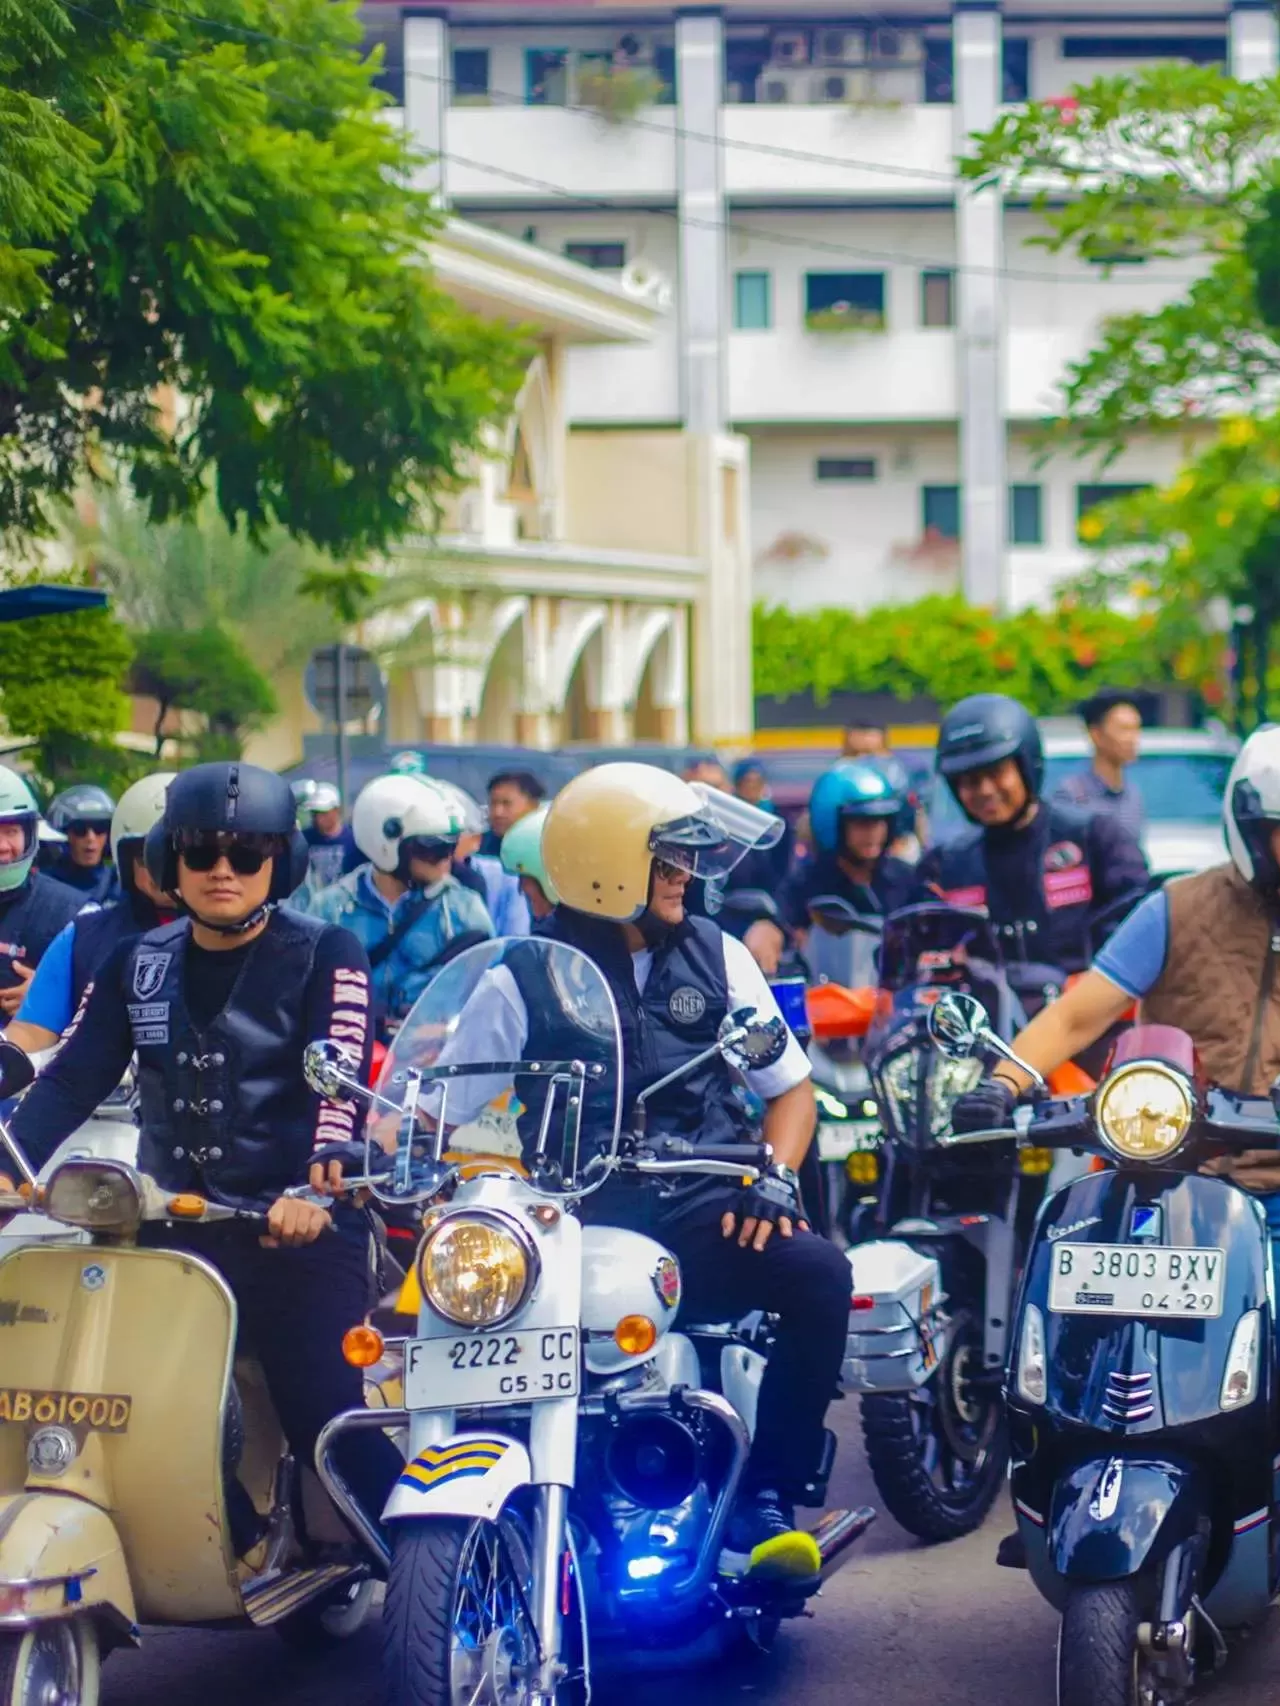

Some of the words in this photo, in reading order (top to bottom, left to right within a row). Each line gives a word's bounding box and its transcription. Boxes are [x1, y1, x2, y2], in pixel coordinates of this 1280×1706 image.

[1059, 1250, 1073, 1276] B
[1092, 1251, 1157, 1278] 3803
[1168, 1254, 1217, 1281] BXV
[409, 1345, 423, 1374] F
[452, 1337, 518, 1369] 2222
[541, 1332, 573, 1362] CC
